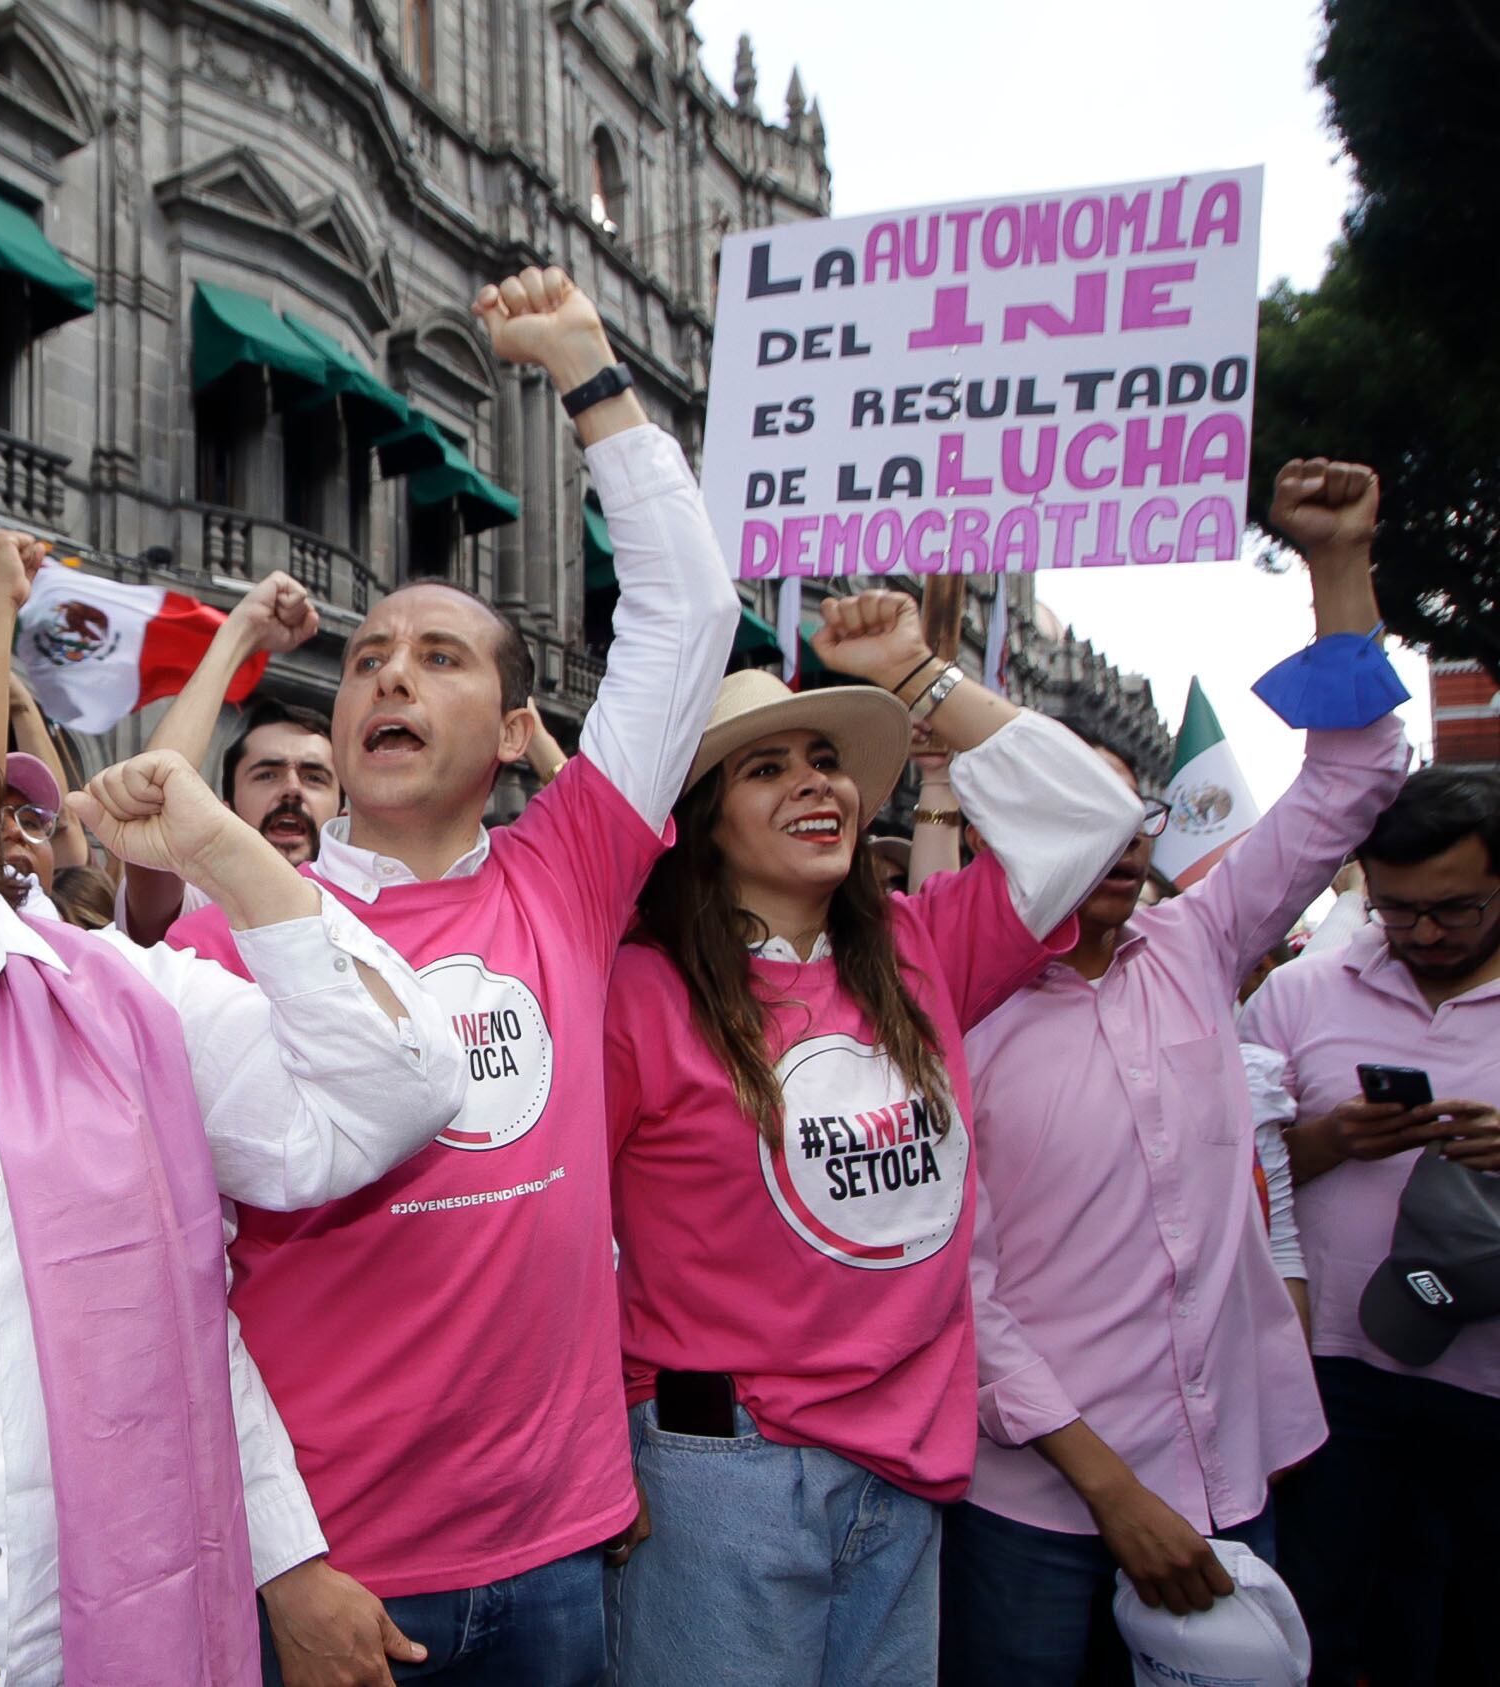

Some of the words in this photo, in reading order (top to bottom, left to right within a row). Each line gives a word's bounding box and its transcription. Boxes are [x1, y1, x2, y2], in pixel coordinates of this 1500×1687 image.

[863, 175, 1242, 284] AUTONOMÍA
[756, 322, 872, 368] DEL
[908, 260, 1197, 351] INE
[752, 397, 815, 438] ES
[851, 355, 1249, 428] RESULTADO
[745, 468, 807, 509] DE
[837, 455, 923, 502] LA
[936, 412, 1245, 498] LUCHA
[739, 492, 1236, 579] DEMOCRÁTICA
[465, 1045, 519, 1082] OCA
[825, 1140, 941, 1201] SETOCA
